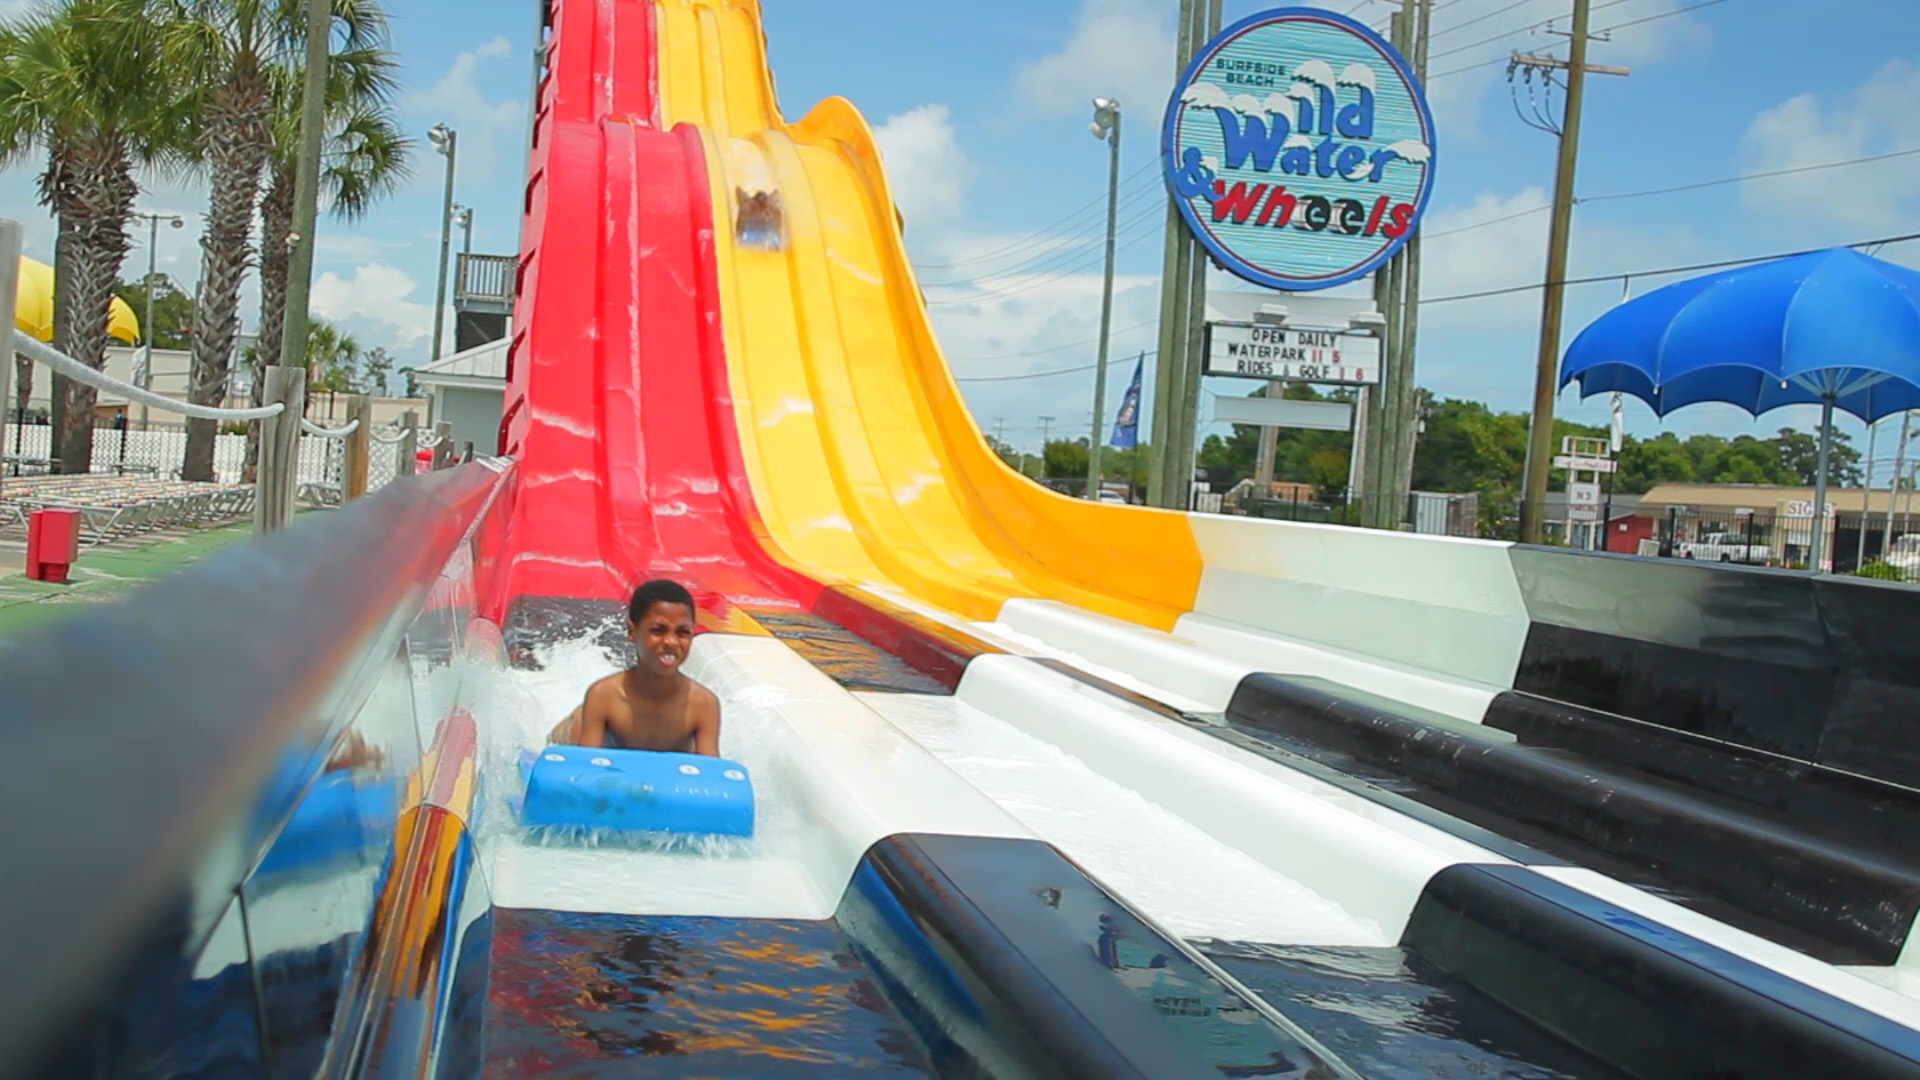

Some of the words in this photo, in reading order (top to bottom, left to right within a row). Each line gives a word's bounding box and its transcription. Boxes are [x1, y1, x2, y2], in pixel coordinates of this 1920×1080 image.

[1216, 58, 1286, 76] SURFSIDE
[1225, 72, 1275, 87] BEACH
[1211, 179, 1415, 238] Wheels
[1252, 328, 1286, 344] OPEN
[1299, 332, 1337, 348] DAILY
[1228, 342, 1306, 363] WATERPARK
[1332, 351, 1340, 363] 5
[1237, 359, 1274, 376] RIDES
[1300, 364, 1330, 379] GOLF
[1355, 369, 1363, 380] 6
[1788, 501, 1831, 516] SIGS
